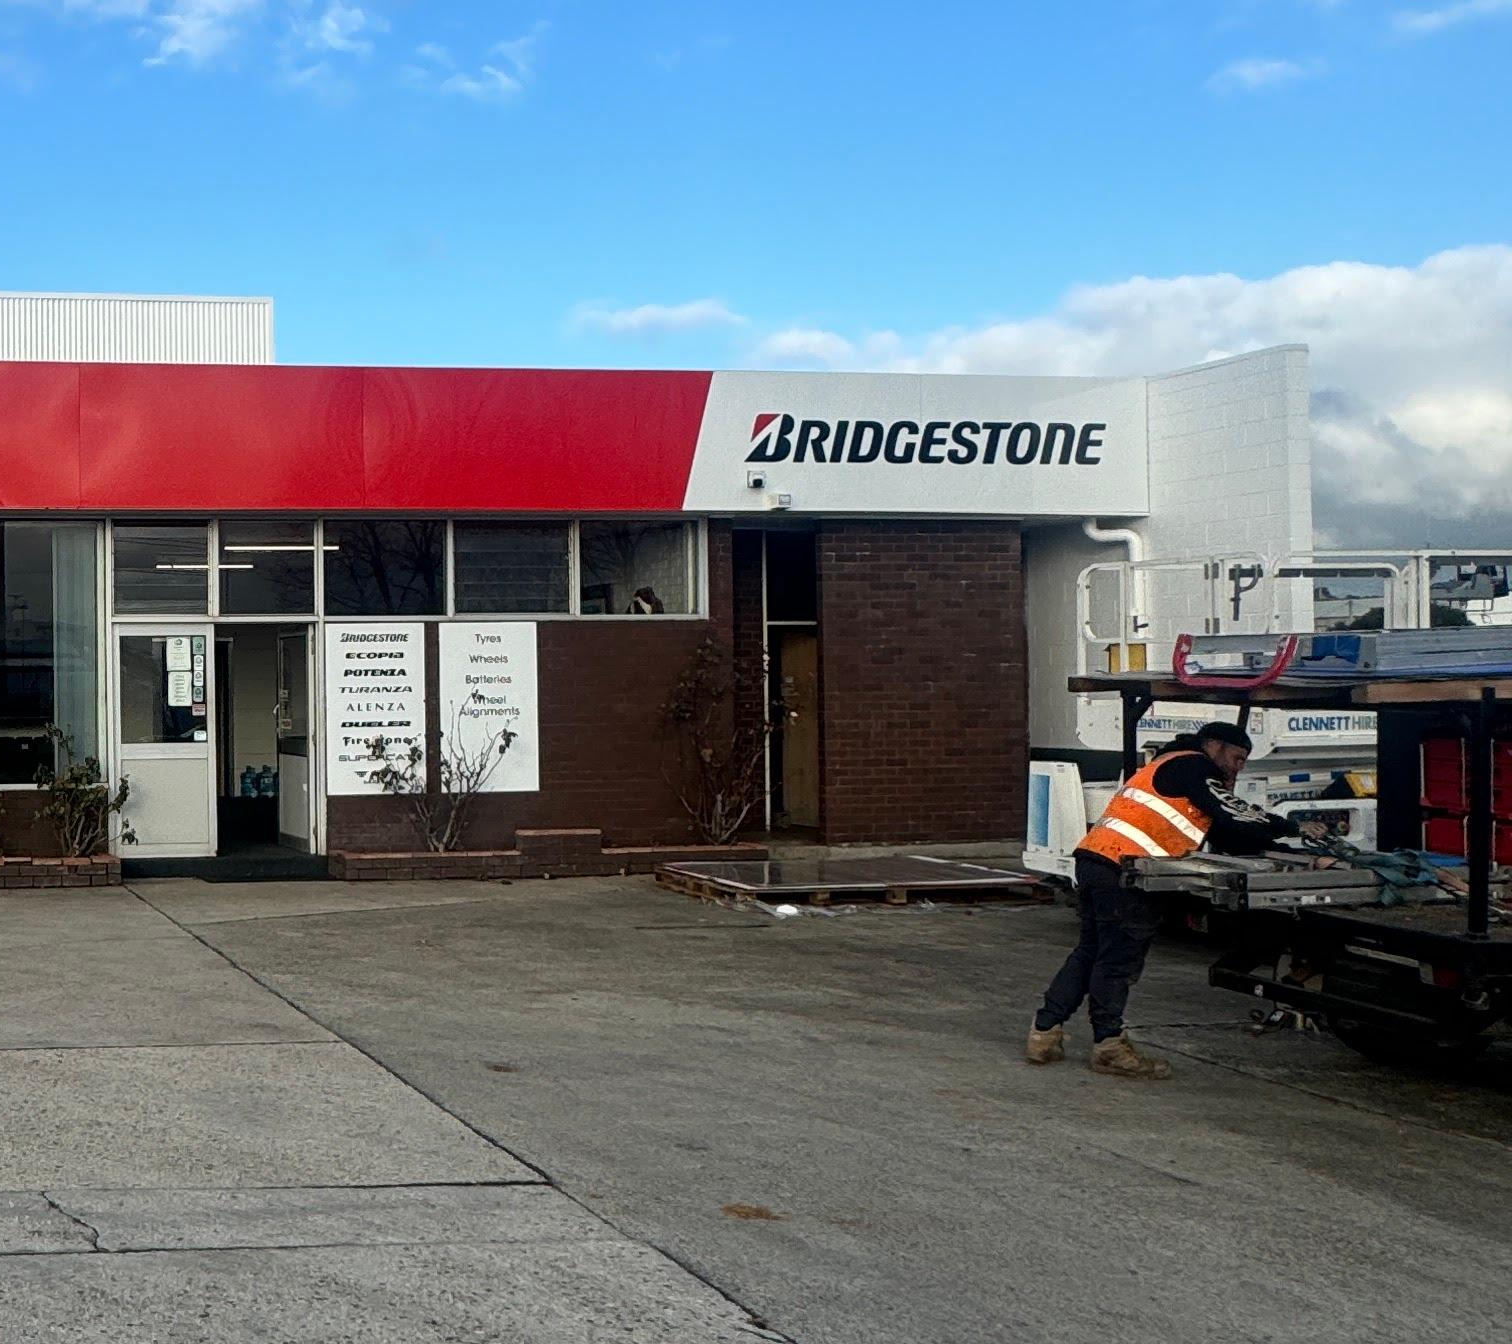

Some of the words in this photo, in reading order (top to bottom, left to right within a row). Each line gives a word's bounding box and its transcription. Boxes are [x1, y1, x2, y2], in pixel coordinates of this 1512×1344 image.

[744, 413, 1107, 465] BRIDGESTONE
[340, 633, 409, 642] BRIDGESTONE
[474, 633, 501, 644] Tyres
[469, 654, 509, 664] Wheels
[343, 668, 408, 677] POTENZA
[465, 674, 512, 684] Batteries
[338, 686, 413, 694] TURANZA
[346, 702, 406, 712] ALENZA
[460, 706, 521, 718] Alignments
[341, 720, 412, 728] DUELER
[1287, 716, 1351, 732] CLENNETT
